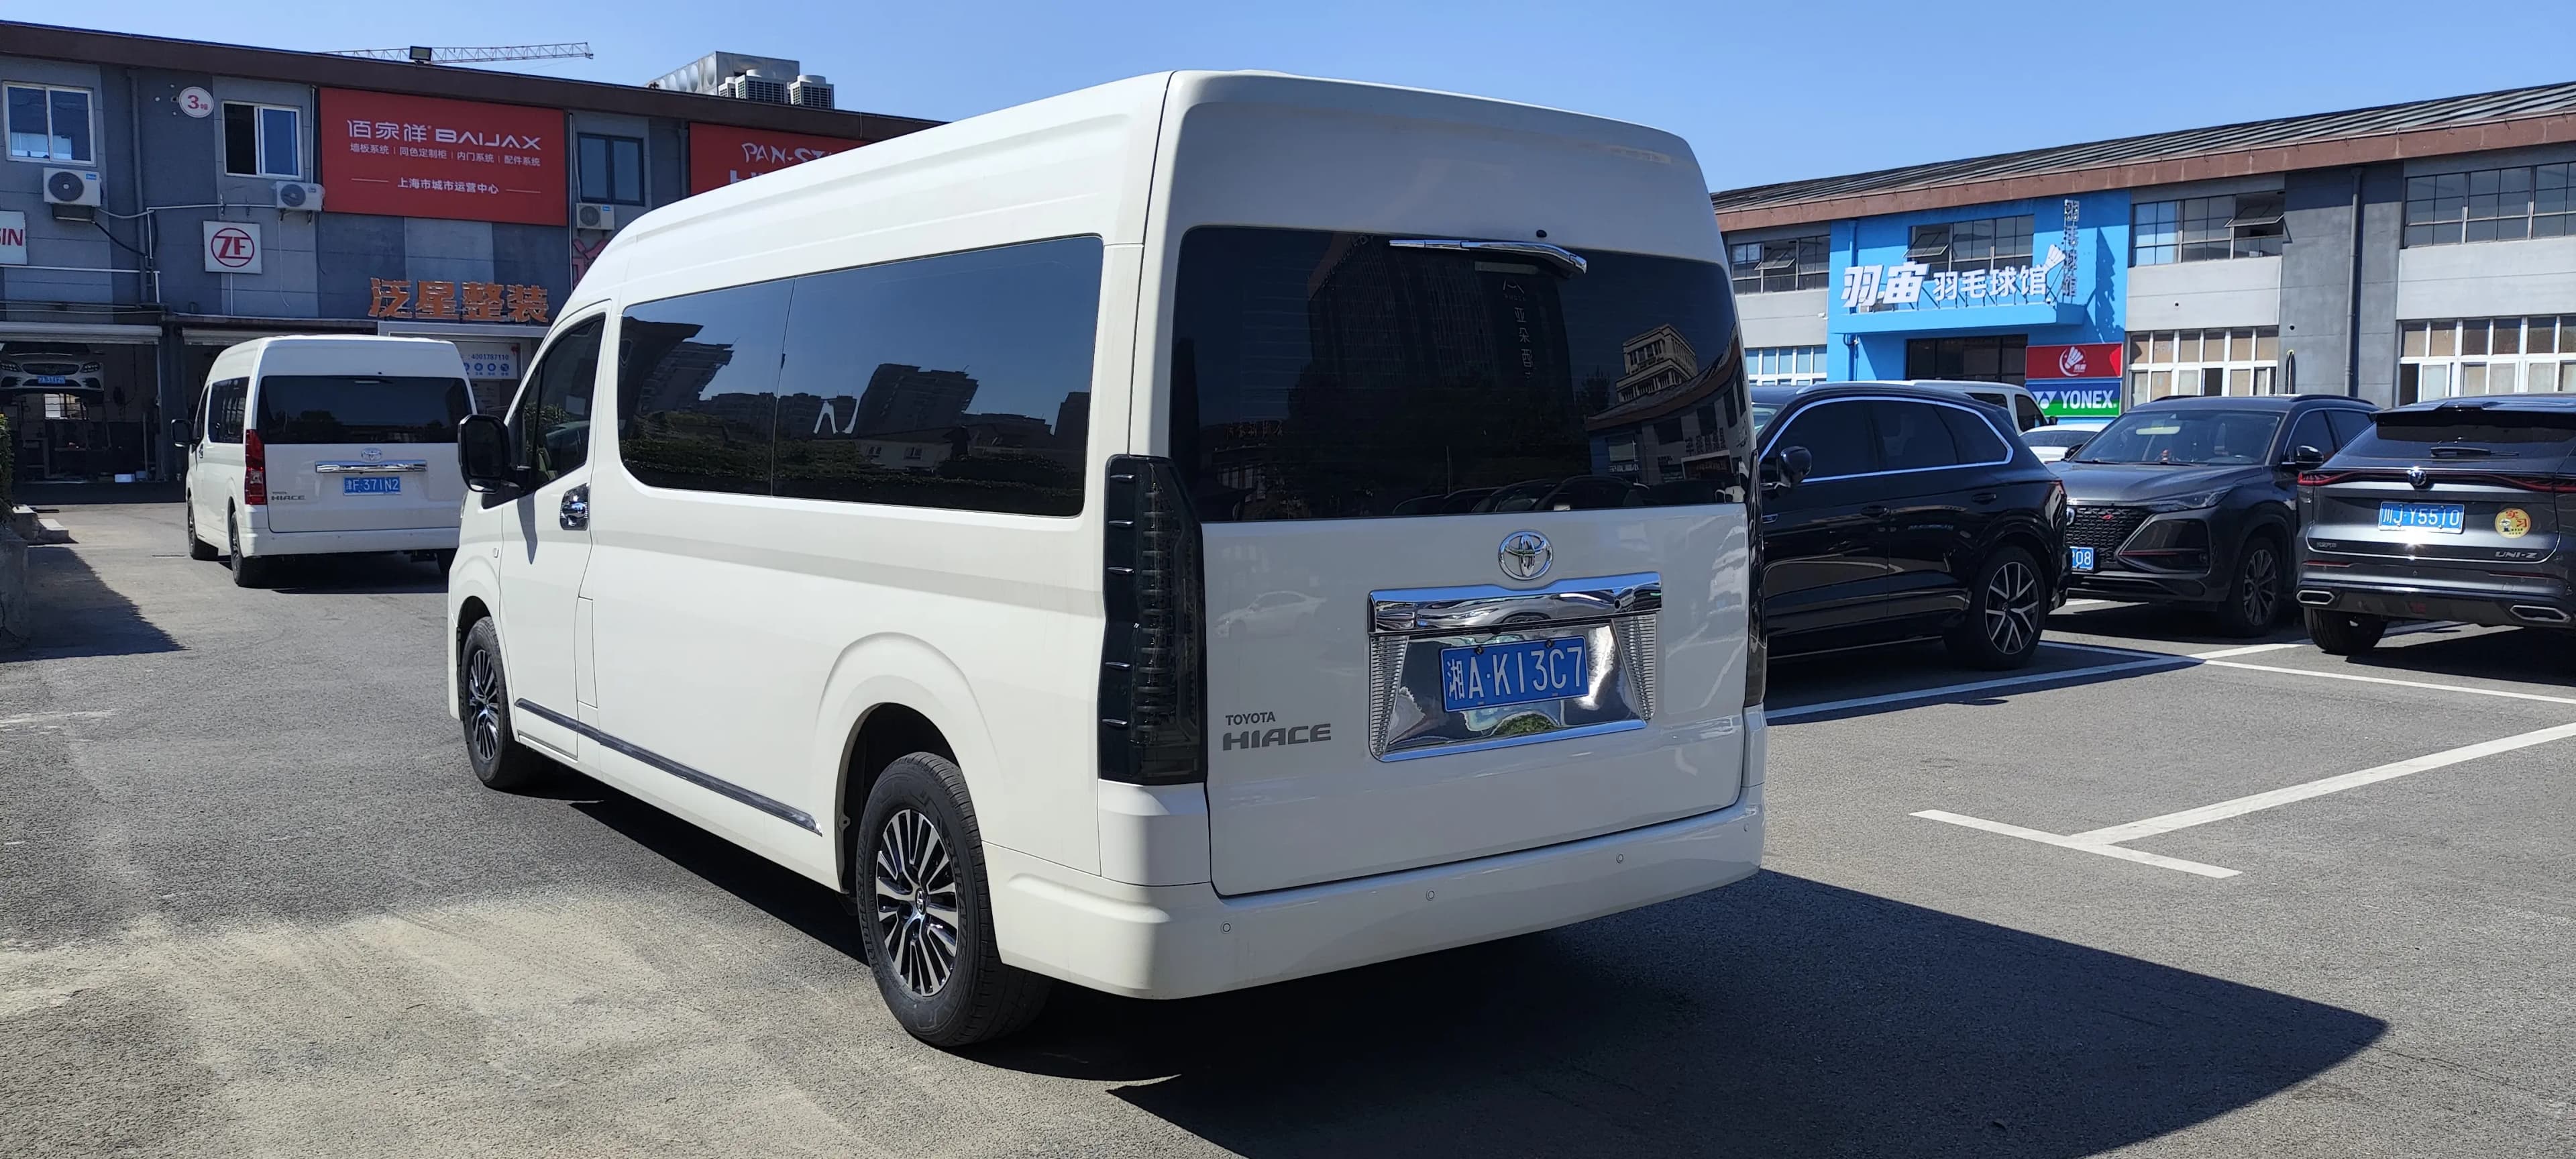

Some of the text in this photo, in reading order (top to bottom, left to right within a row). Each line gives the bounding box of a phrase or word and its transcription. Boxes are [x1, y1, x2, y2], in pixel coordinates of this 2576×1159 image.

[436, 128, 542, 150] BAIJAX
[350, 142, 541, 166] 墙板系统 同色定制柜 内门系统 配件系统
[741, 142, 832, 164] PAN-S
[397, 177, 500, 195] 上海市城市运营中心
[0, 228, 23, 246] IN
[213, 235, 252, 260] ZF
[1933, 263, 2050, 301] 羽毛球馆
[368, 277, 549, 323] 泛星整装
[2060, 390, 2114, 409] YONEX
[2495, 550, 2538, 559] UNI-Z
[1225, 711, 1276, 725] TOYOTA
[1222, 723, 1332, 751] HIACE
